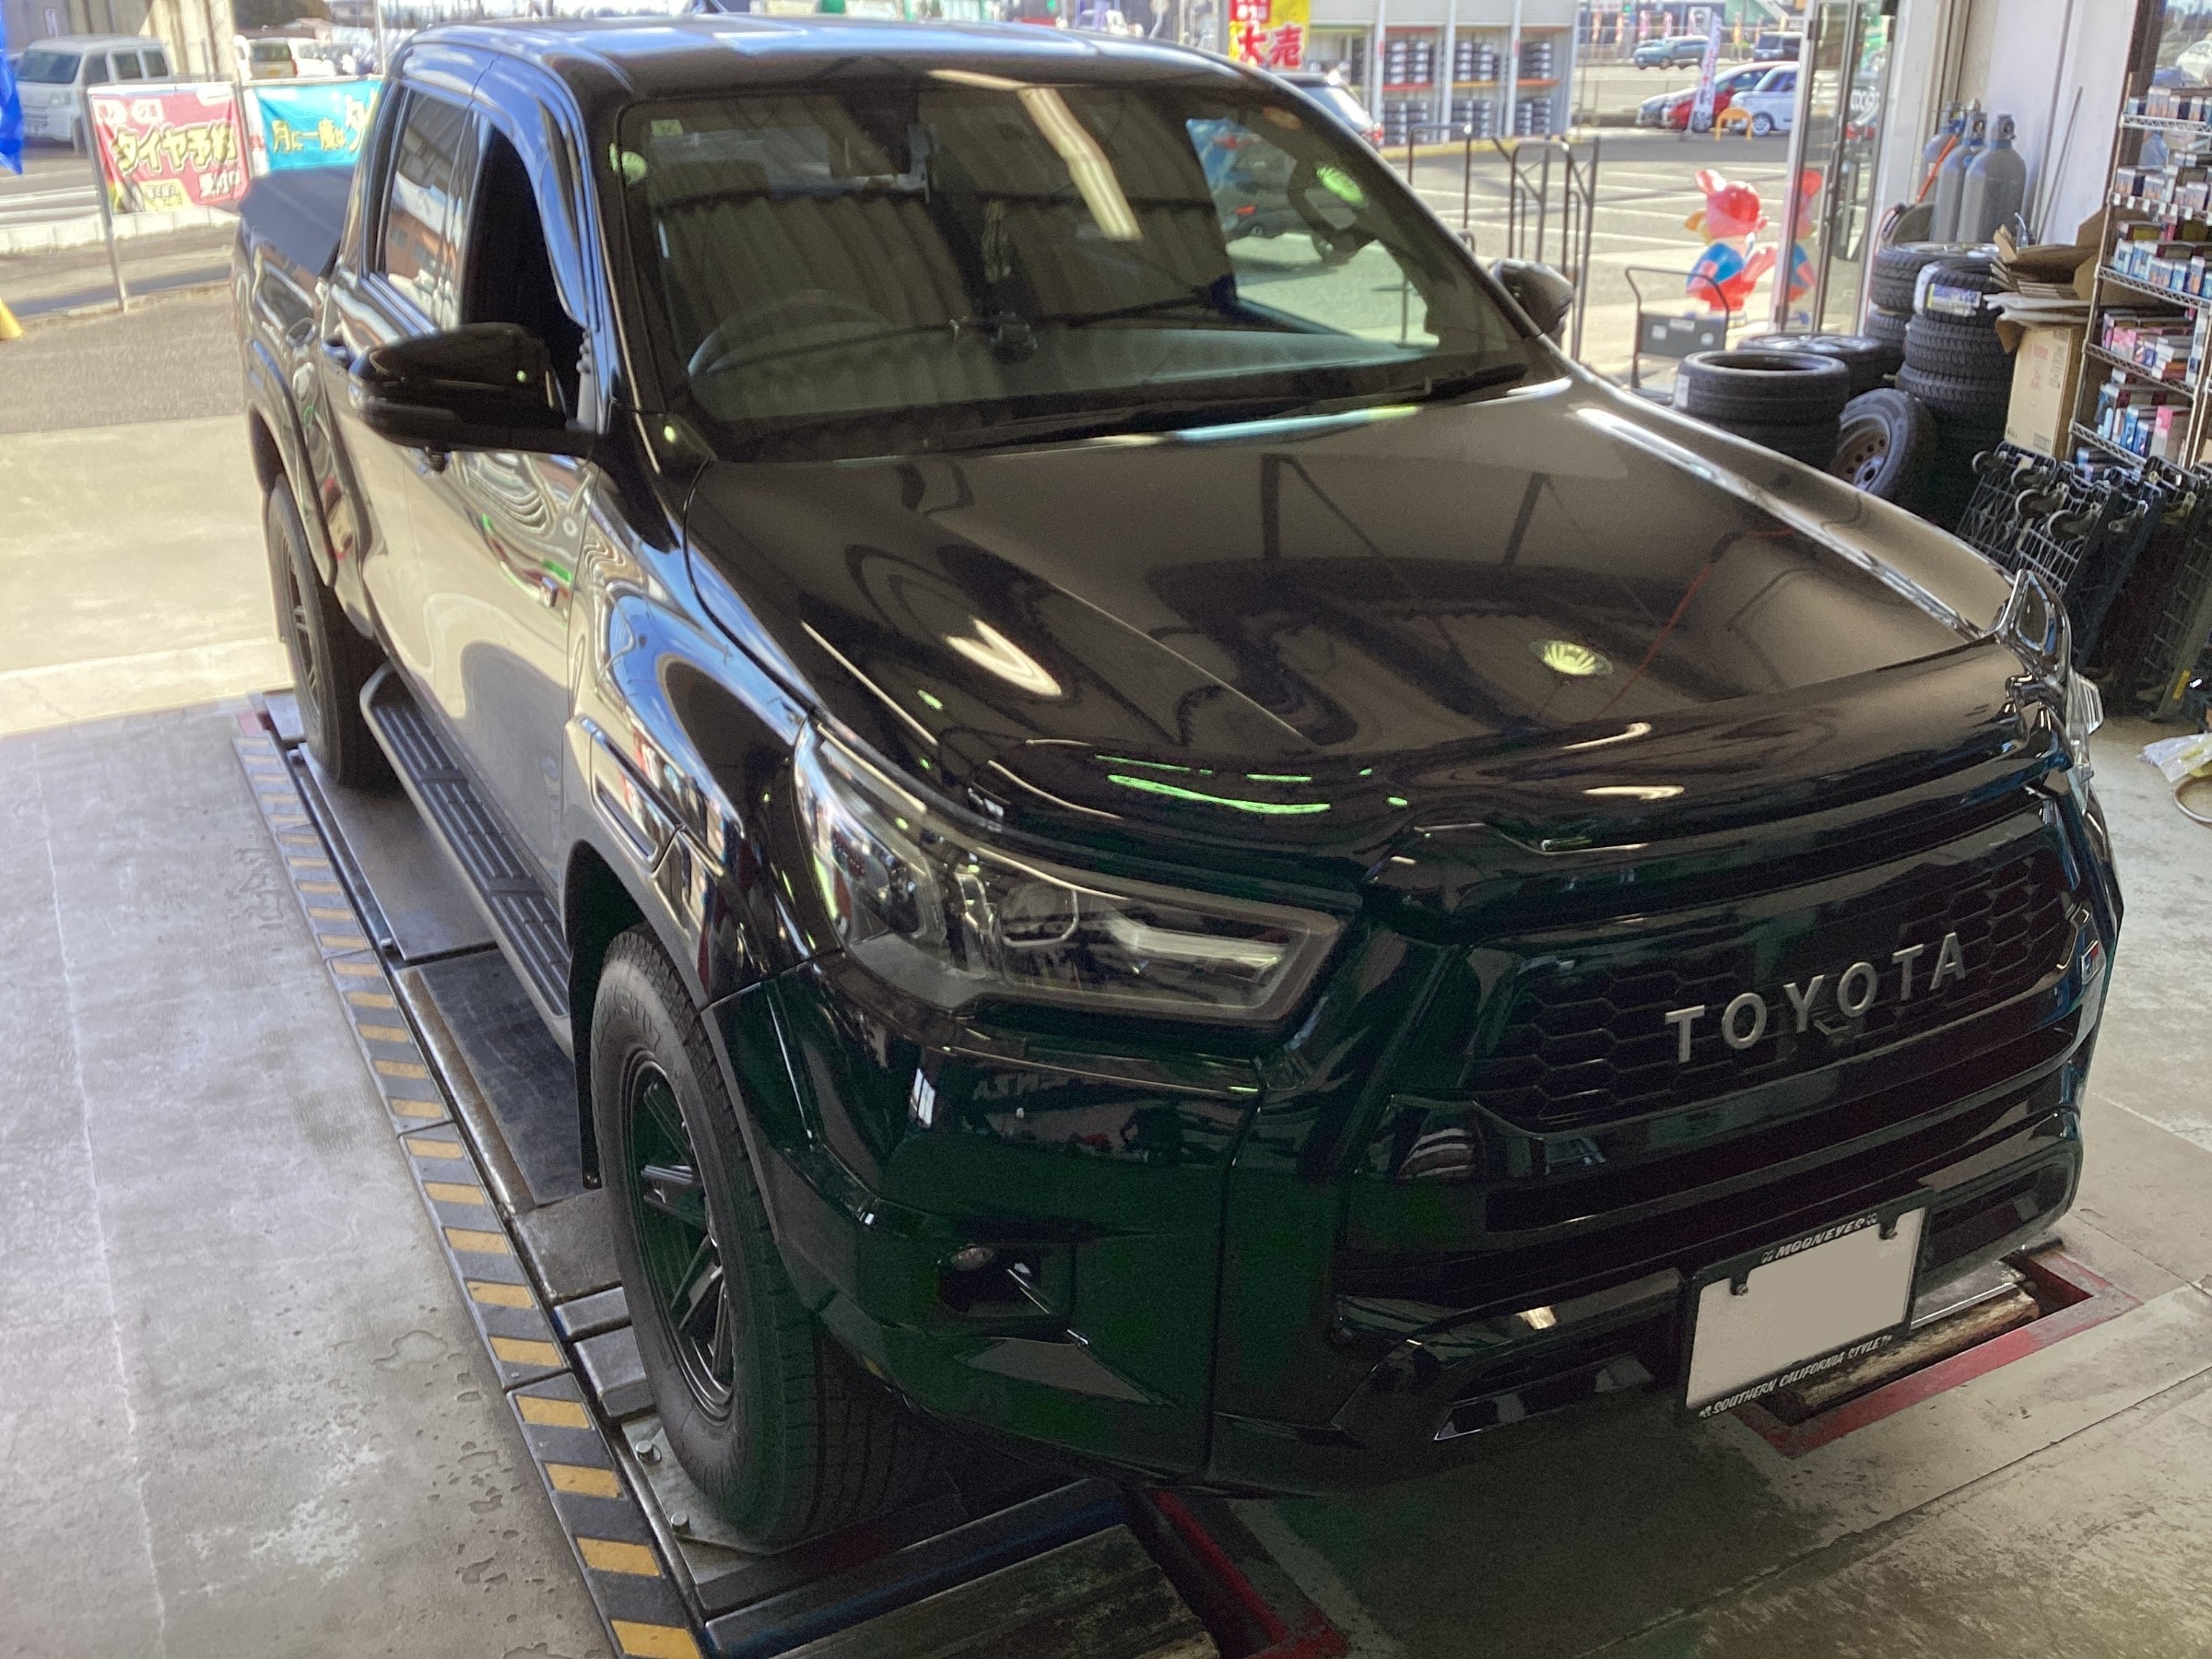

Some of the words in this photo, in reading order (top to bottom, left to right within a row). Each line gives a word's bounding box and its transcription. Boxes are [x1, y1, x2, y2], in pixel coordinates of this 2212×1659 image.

[1665, 932, 1966, 1064] TOYOTA
[1774, 1218, 1865, 1259] MOONEYES
[1713, 1378, 1779, 1415] SOUTHERN
[1779, 1351, 1845, 1388] CALIFORNIA
[1847, 1336, 1882, 1360] STYLE
